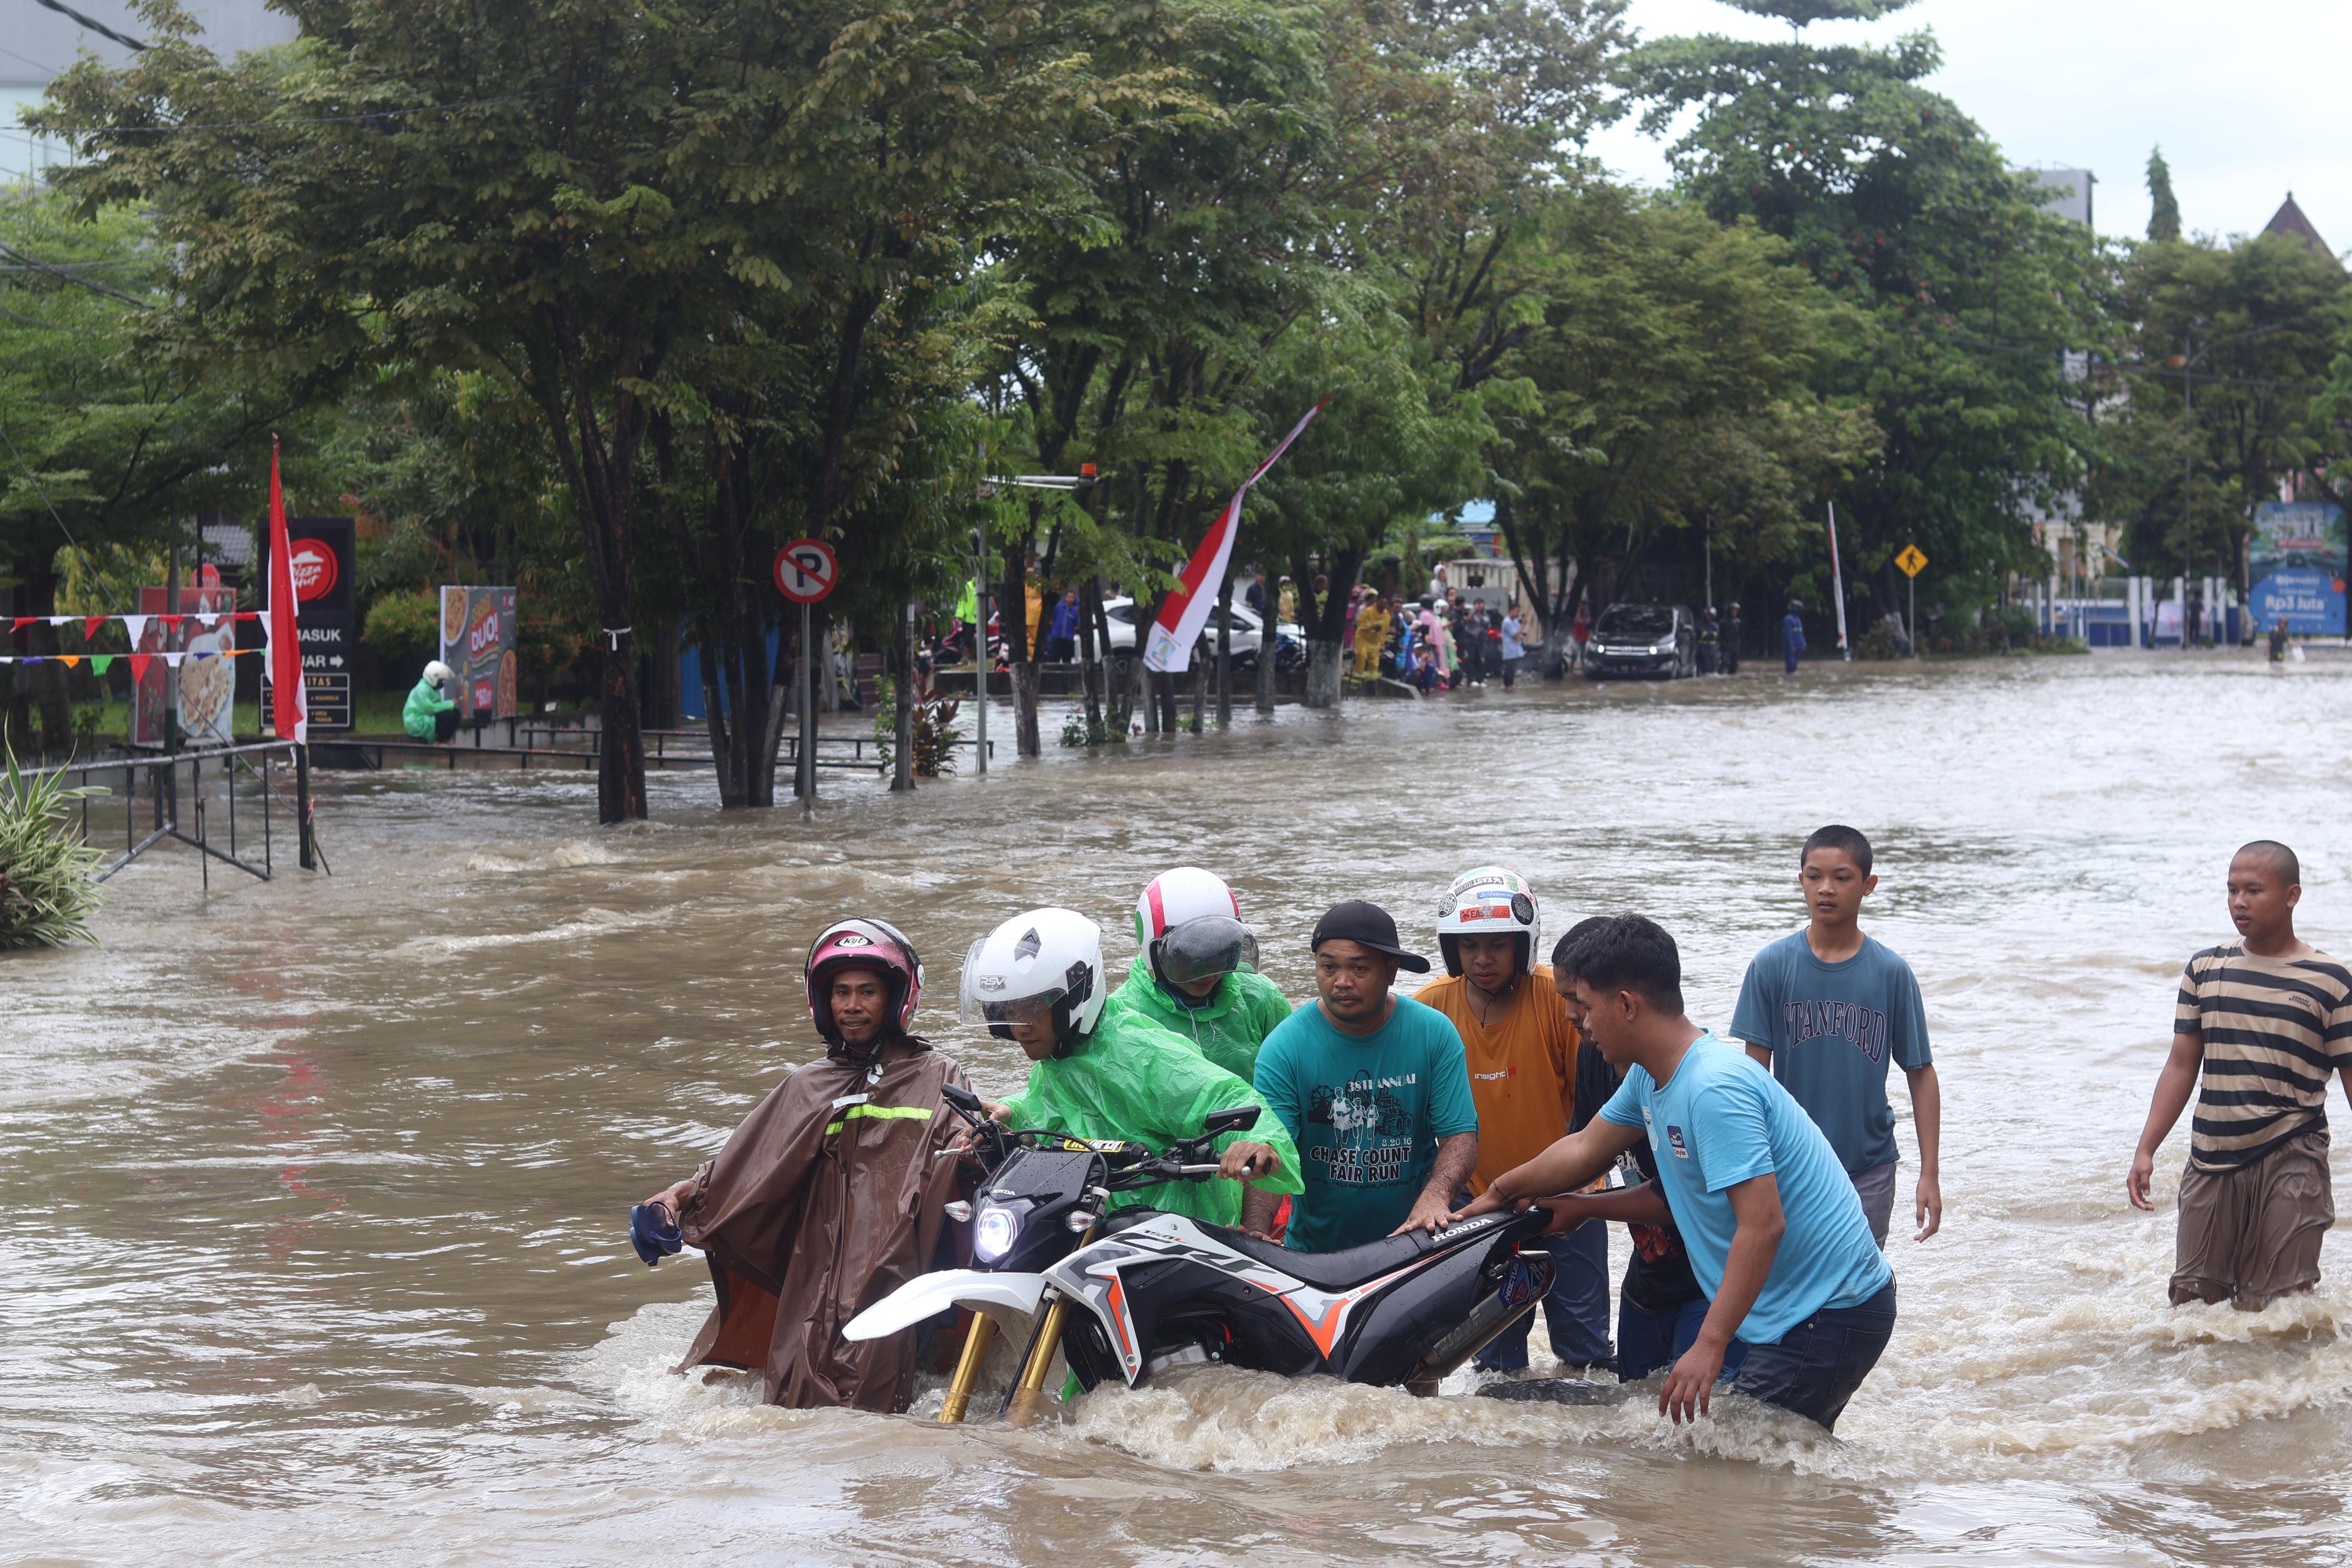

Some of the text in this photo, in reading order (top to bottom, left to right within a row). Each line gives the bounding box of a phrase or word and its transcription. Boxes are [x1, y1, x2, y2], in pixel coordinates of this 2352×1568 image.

[293, 563, 322, 577] izza
[471, 612, 499, 652] DUO!
[980, 976, 1007, 985] RSV
[1377, 1073, 1417, 1089] ANNUAL
[1474, 1071, 1506, 1080] insight
[1381, 1137, 1412, 1146] 8.20.16
[1310, 1146, 1413, 1167] CHASE COUNT
[1329, 1163, 1364, 1183] FAIR
[1368, 1162, 1401, 1182] RUN
[1431, 1218, 1494, 1242] HONDA
